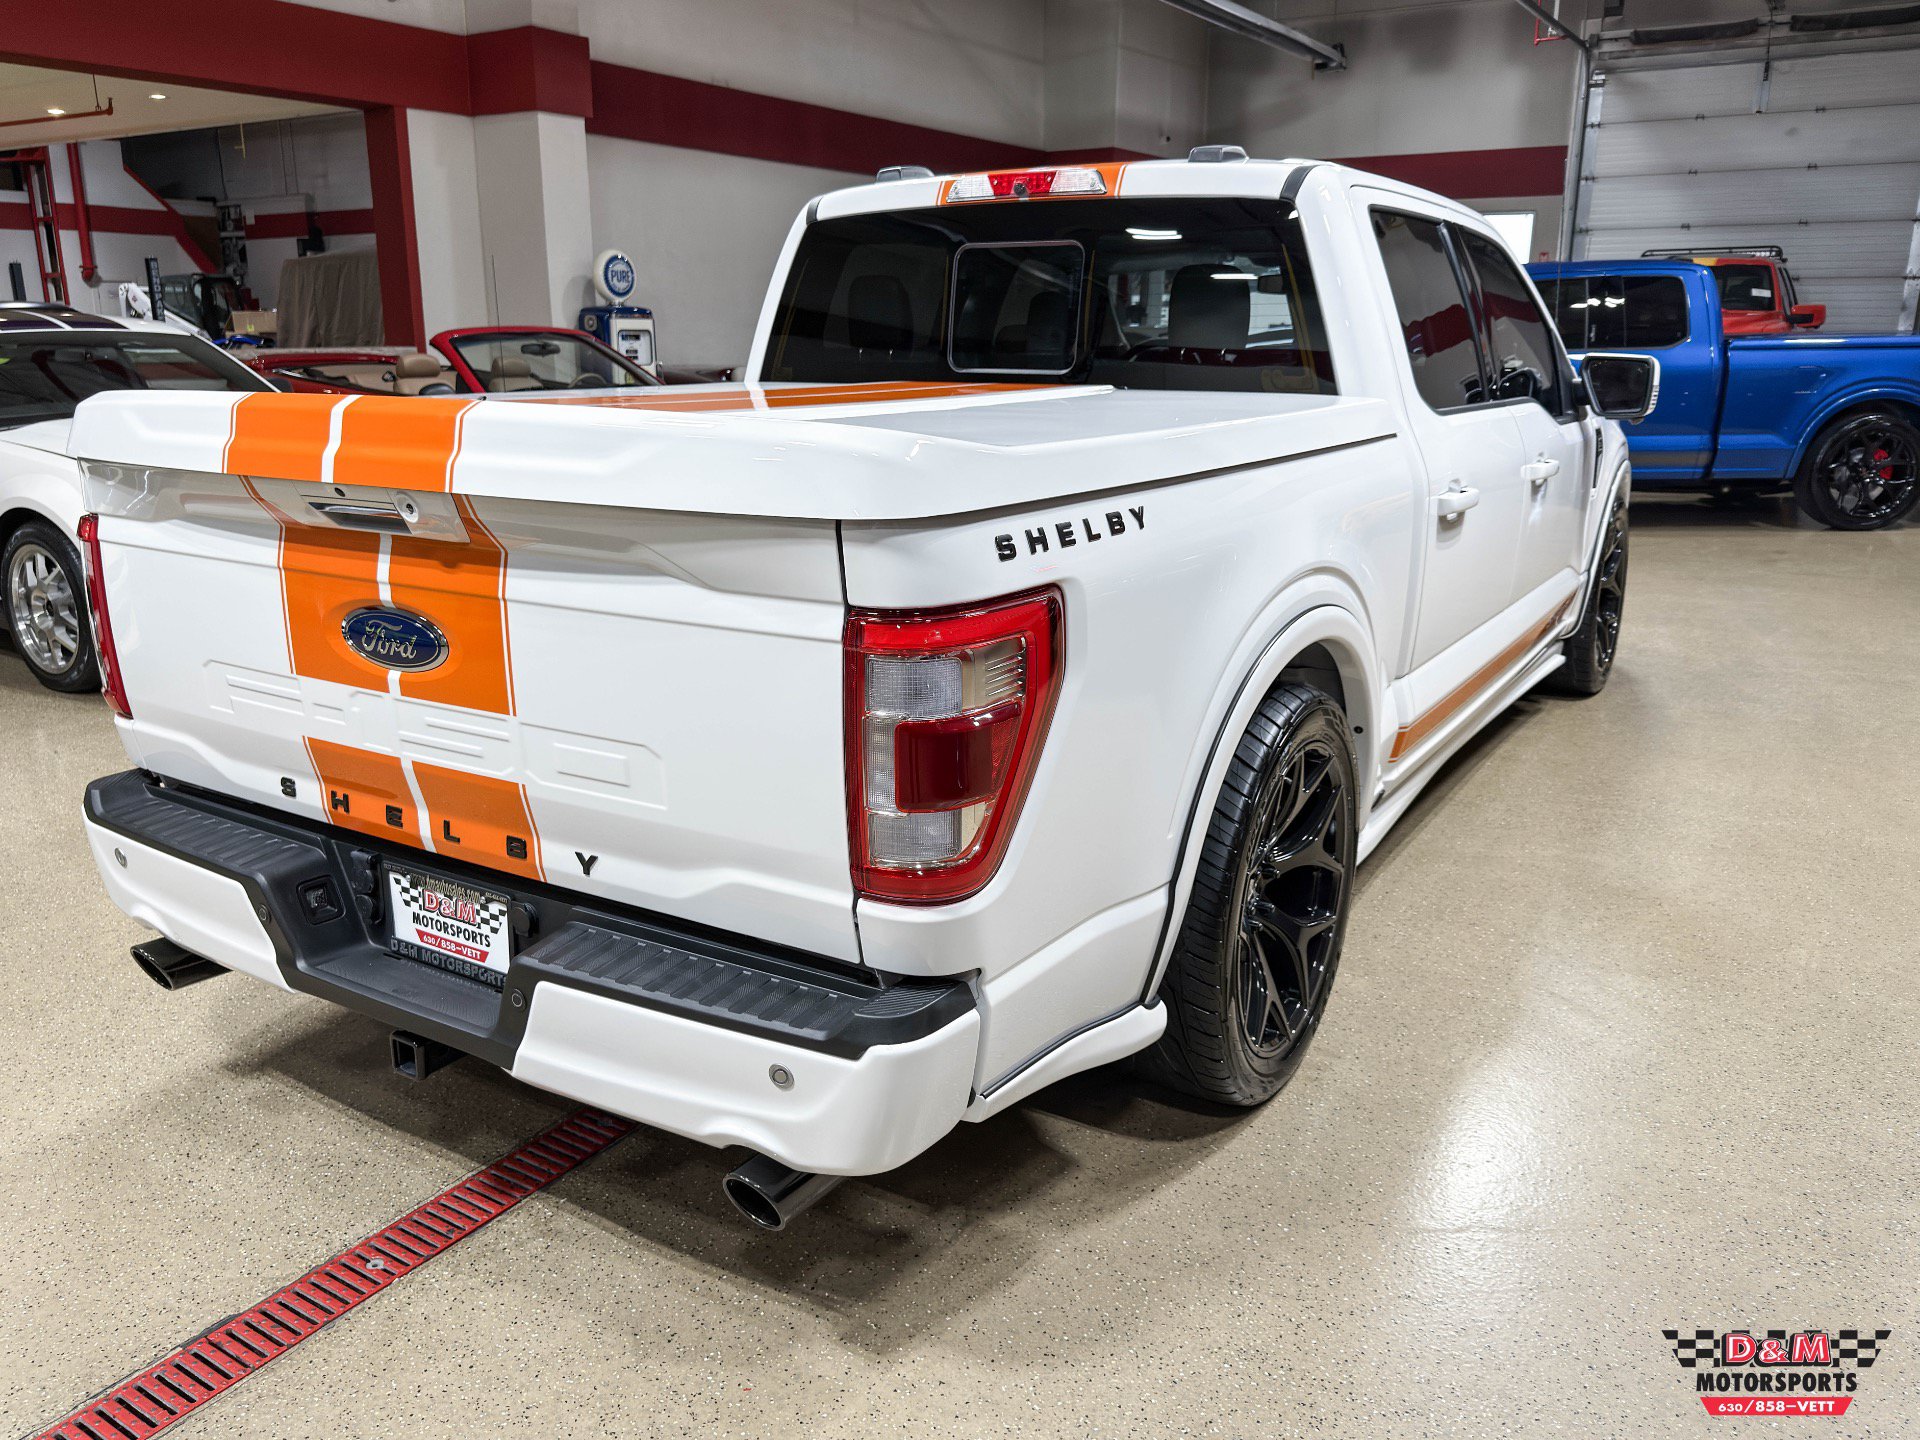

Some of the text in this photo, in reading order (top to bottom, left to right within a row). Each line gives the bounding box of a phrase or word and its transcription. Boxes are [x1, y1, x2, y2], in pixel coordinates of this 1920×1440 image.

[610, 269, 631, 283] PURE
[994, 505, 1145, 563] SHELBY
[361, 619, 418, 659] Ford
[280, 776, 599, 876] SHELBY
[423, 889, 478, 924] D&M
[412, 911, 491, 948] MOTORSPORTS
[390, 940, 418, 959] D&M
